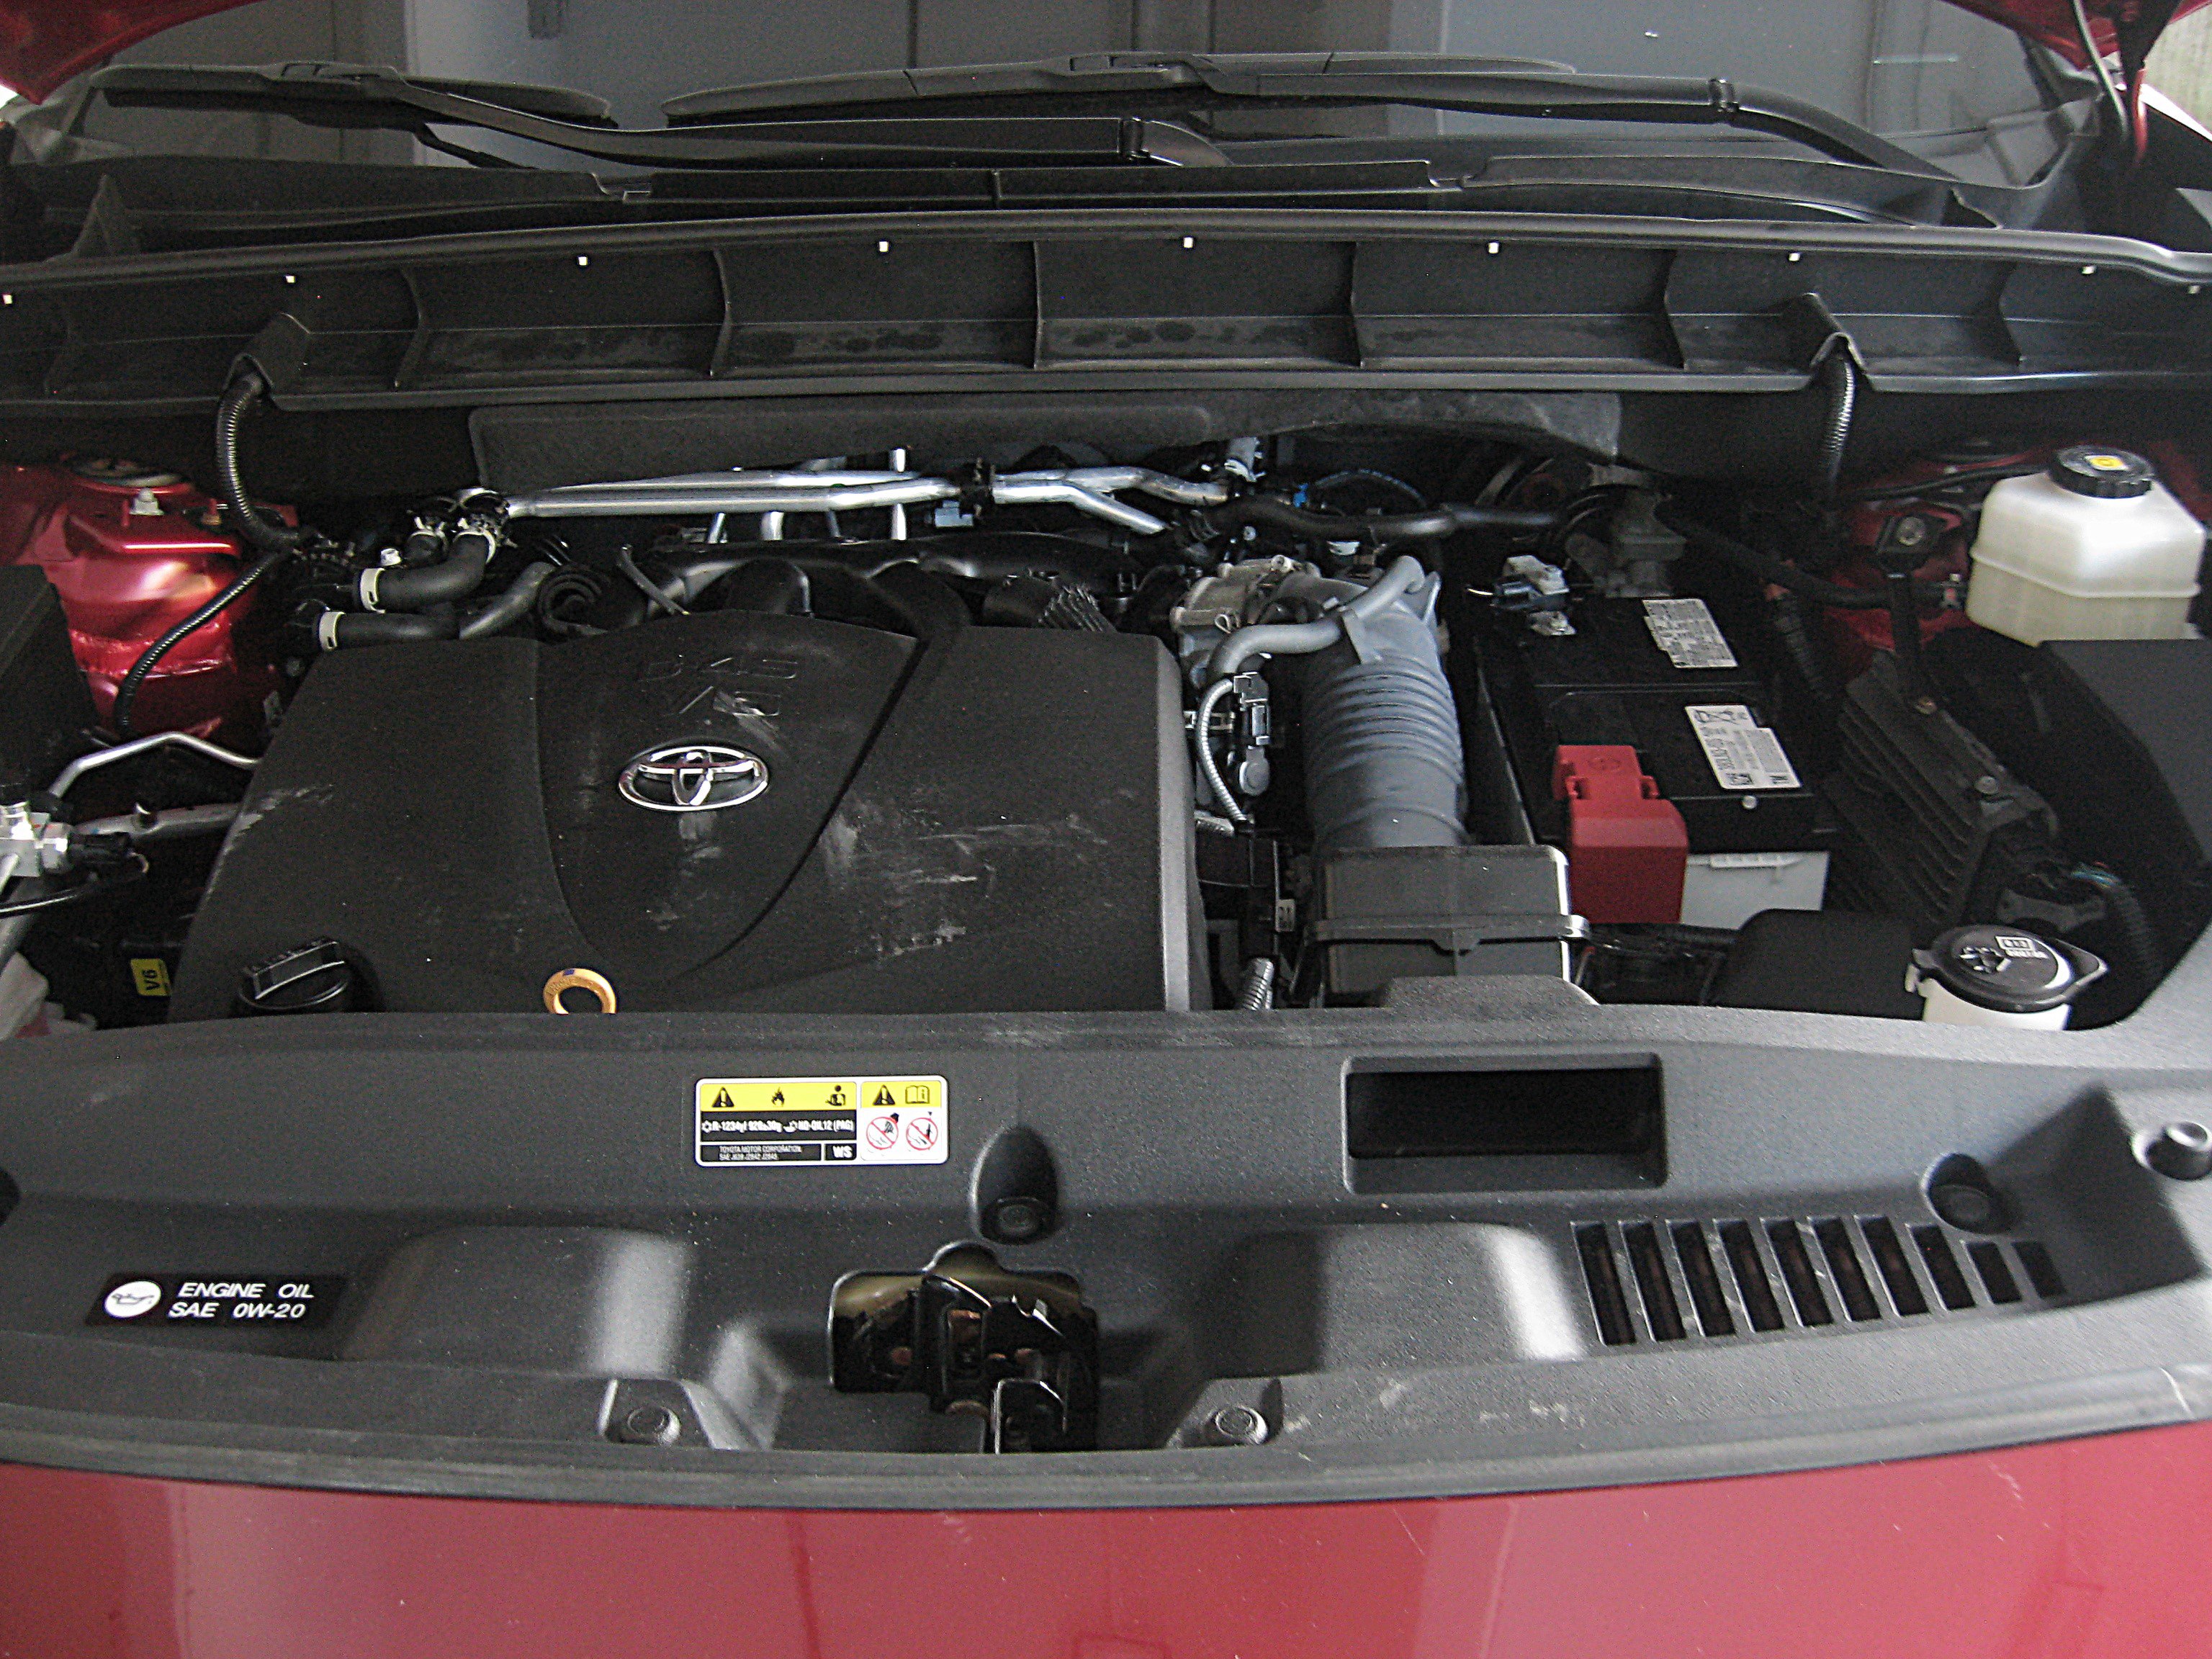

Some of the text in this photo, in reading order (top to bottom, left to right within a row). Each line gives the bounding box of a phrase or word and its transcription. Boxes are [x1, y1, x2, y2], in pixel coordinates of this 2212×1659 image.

[832, 1146, 853, 1158] WS
[177, 1282, 314, 1298] ENGINE OIL
[167, 1302, 306, 1319] SAE 0W-20
